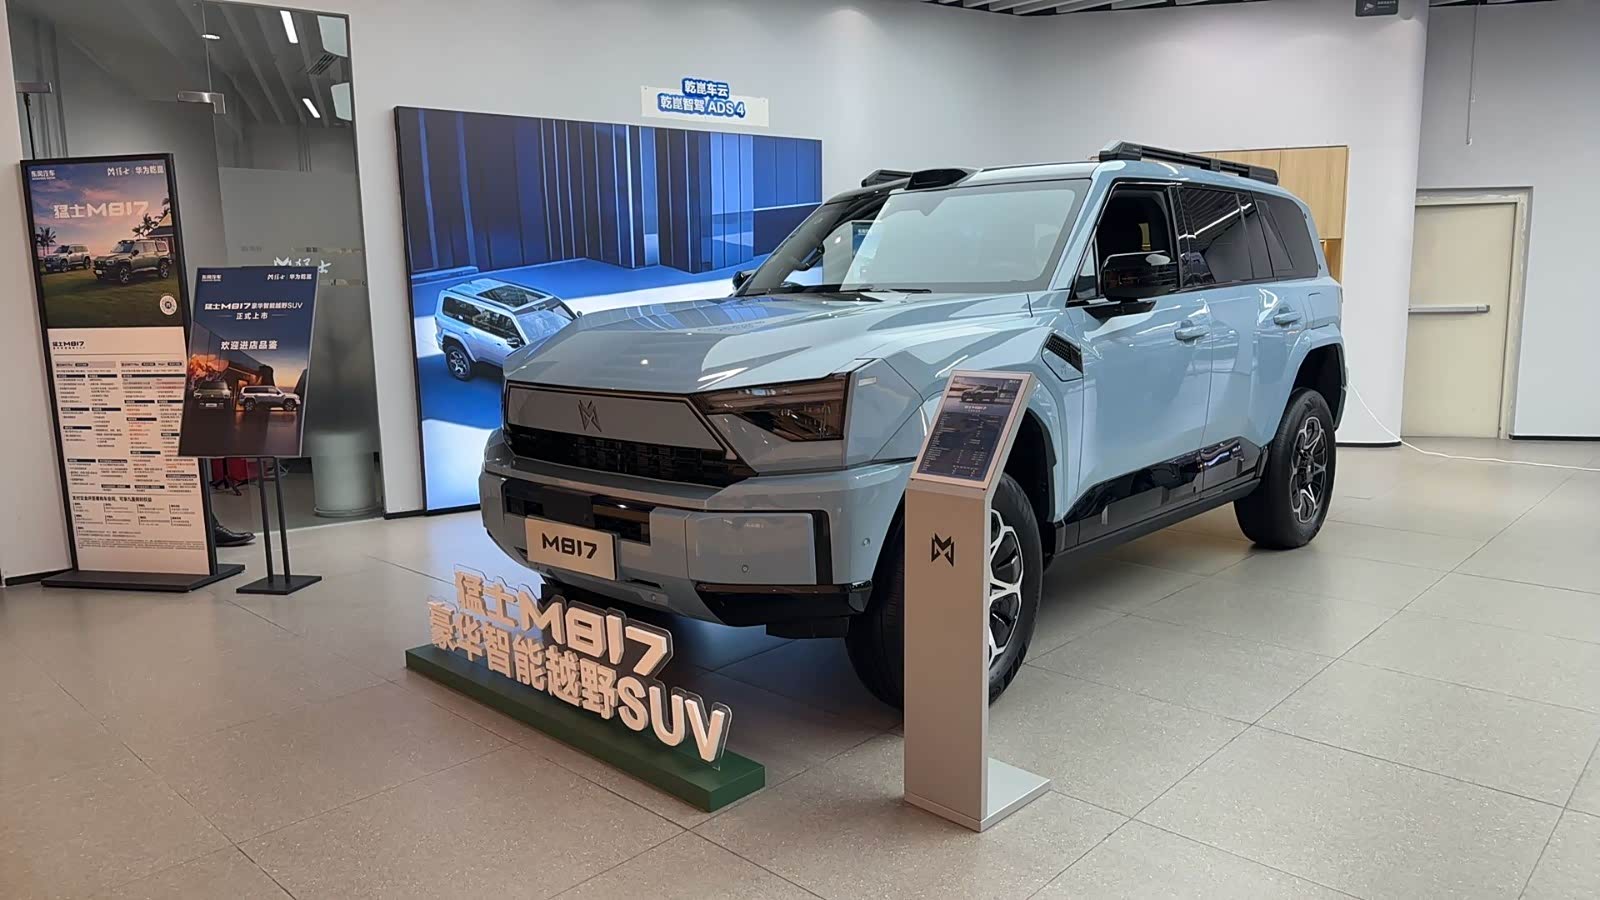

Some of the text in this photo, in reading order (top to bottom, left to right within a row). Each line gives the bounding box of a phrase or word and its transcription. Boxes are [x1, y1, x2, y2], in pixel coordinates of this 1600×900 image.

[684, 80, 729, 97] 乾崑车云
[660, 95, 745, 116] 乾崑智驾 ADS 4
[53, 201, 149, 219] 猛士M817
[235, 311, 269, 320] 正式上市
[220, 340, 278, 351] 欢迎进店品鉴
[541, 532, 598, 560] M817
[454, 570, 670, 677] 猛士M817
[427, 600, 725, 763] 豪华智能越野SUV
